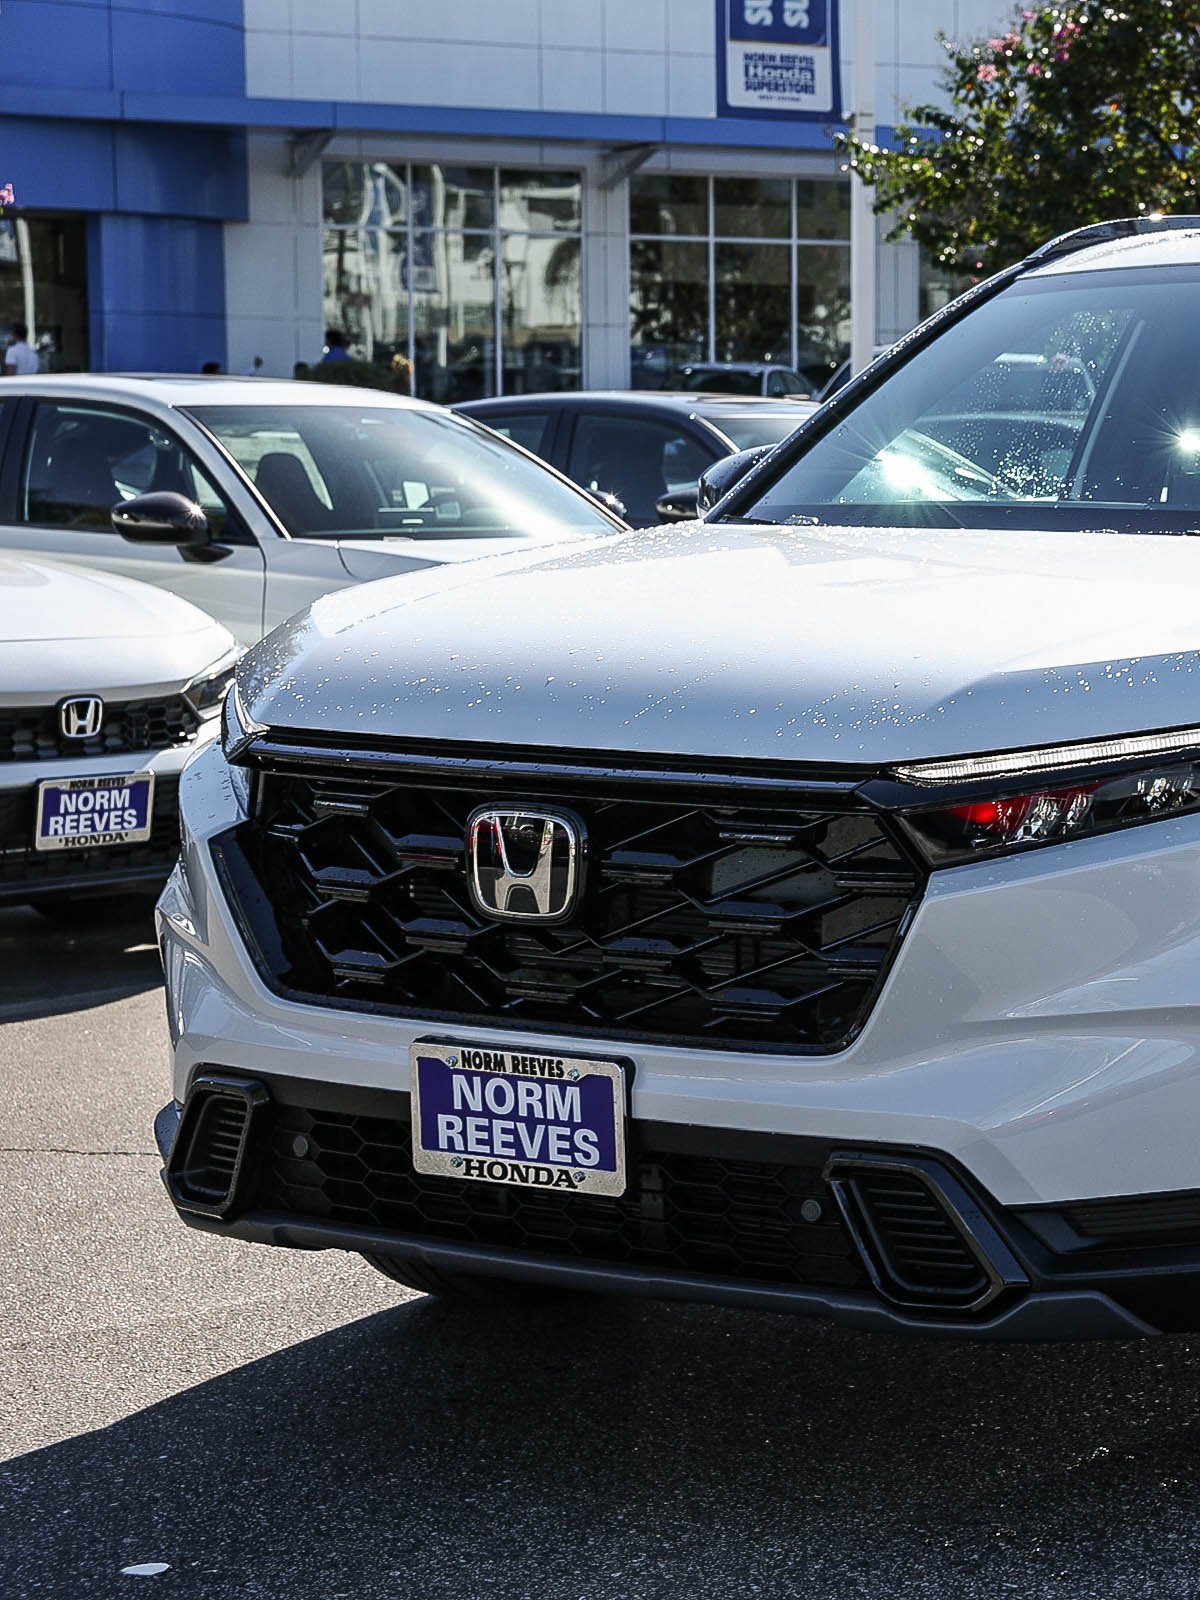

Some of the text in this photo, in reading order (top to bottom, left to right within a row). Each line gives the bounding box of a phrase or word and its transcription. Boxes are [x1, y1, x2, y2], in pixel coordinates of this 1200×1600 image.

[748, 64, 812, 82] Honda
[745, 80, 815, 95] SUPERSTORE
[60, 789, 130, 814] NORM
[49, 809, 138, 836] REEVES
[63, 832, 125, 847] HONDA
[461, 1050, 565, 1078] NORM REEVES
[452, 1074, 582, 1123] NORM
[437, 1113, 600, 1167] REEVES
[463, 1157, 578, 1189] HONDA
